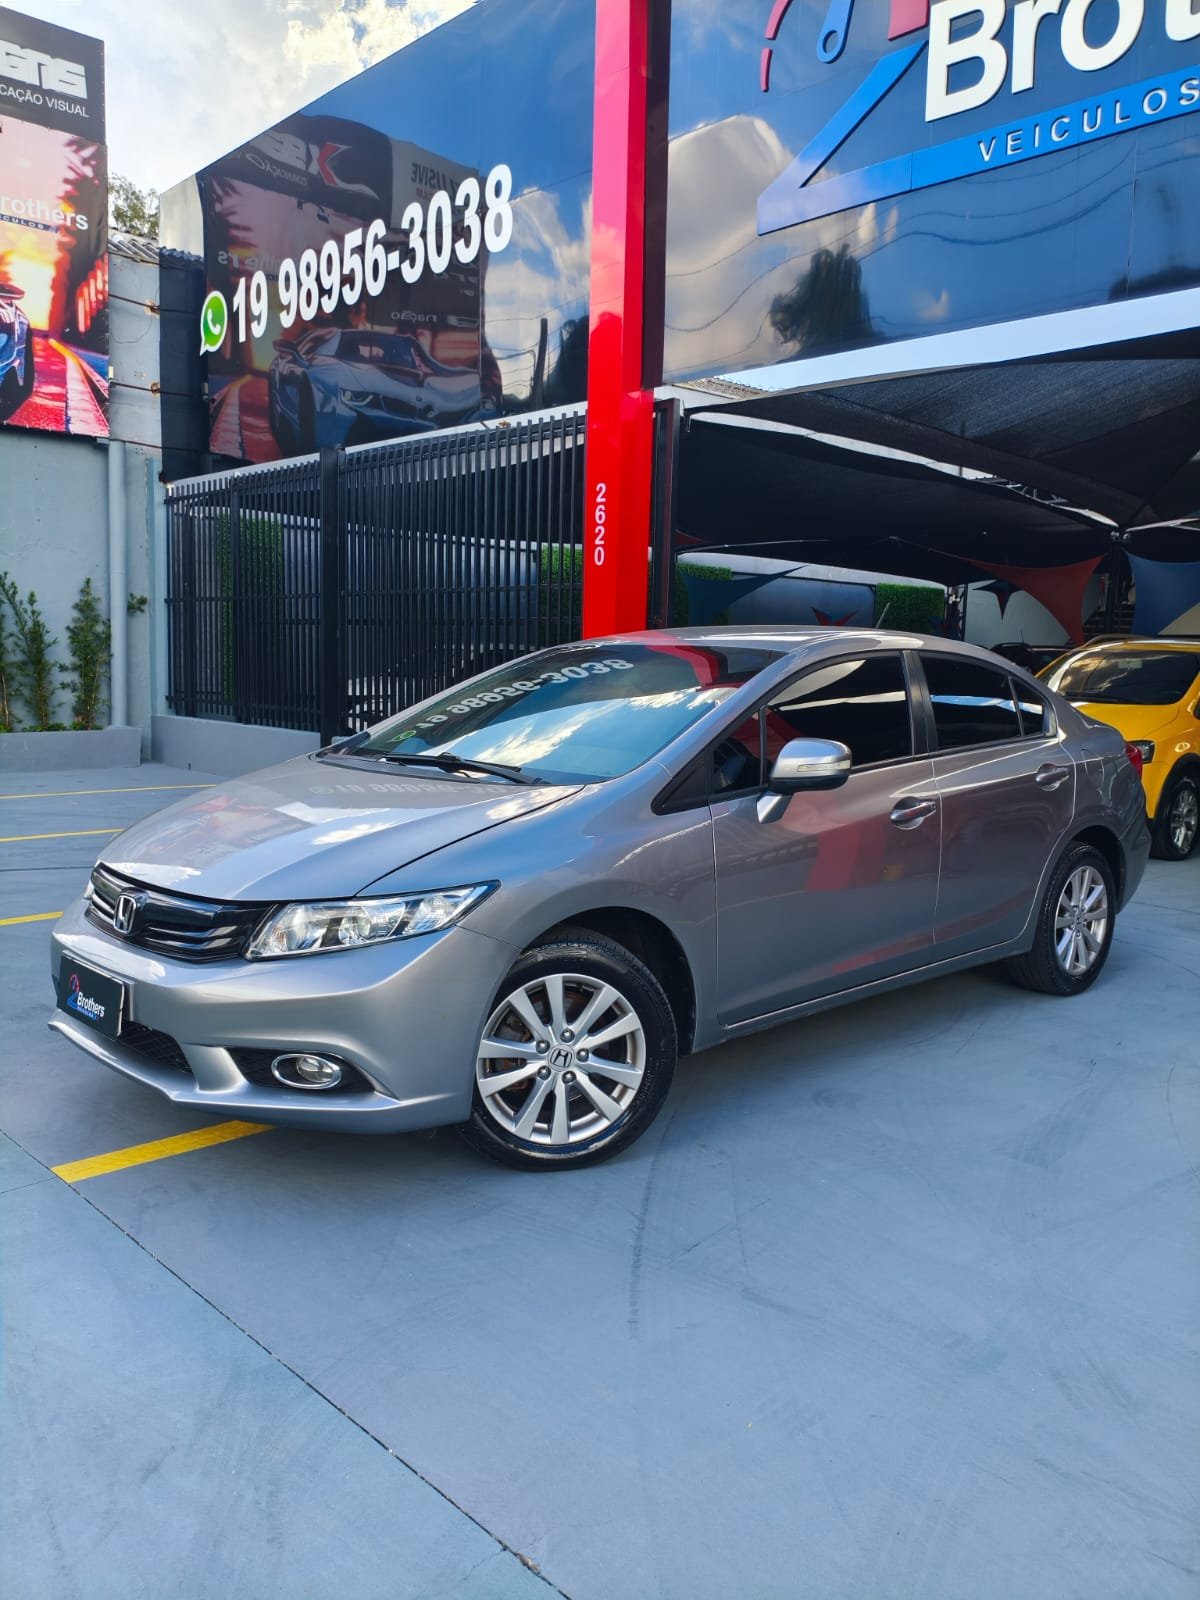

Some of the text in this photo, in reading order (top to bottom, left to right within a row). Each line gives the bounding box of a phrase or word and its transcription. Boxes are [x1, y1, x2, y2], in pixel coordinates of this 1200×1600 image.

[45, 96, 89, 118] VISUAL
[978, 77, 1200, 162] VEICULOS
[0, 196, 89, 231] rothers
[233, 164, 513, 343] 19 98956-3038
[594, 483, 606, 566] 2620
[77, 991, 105, 1018] Brothers
